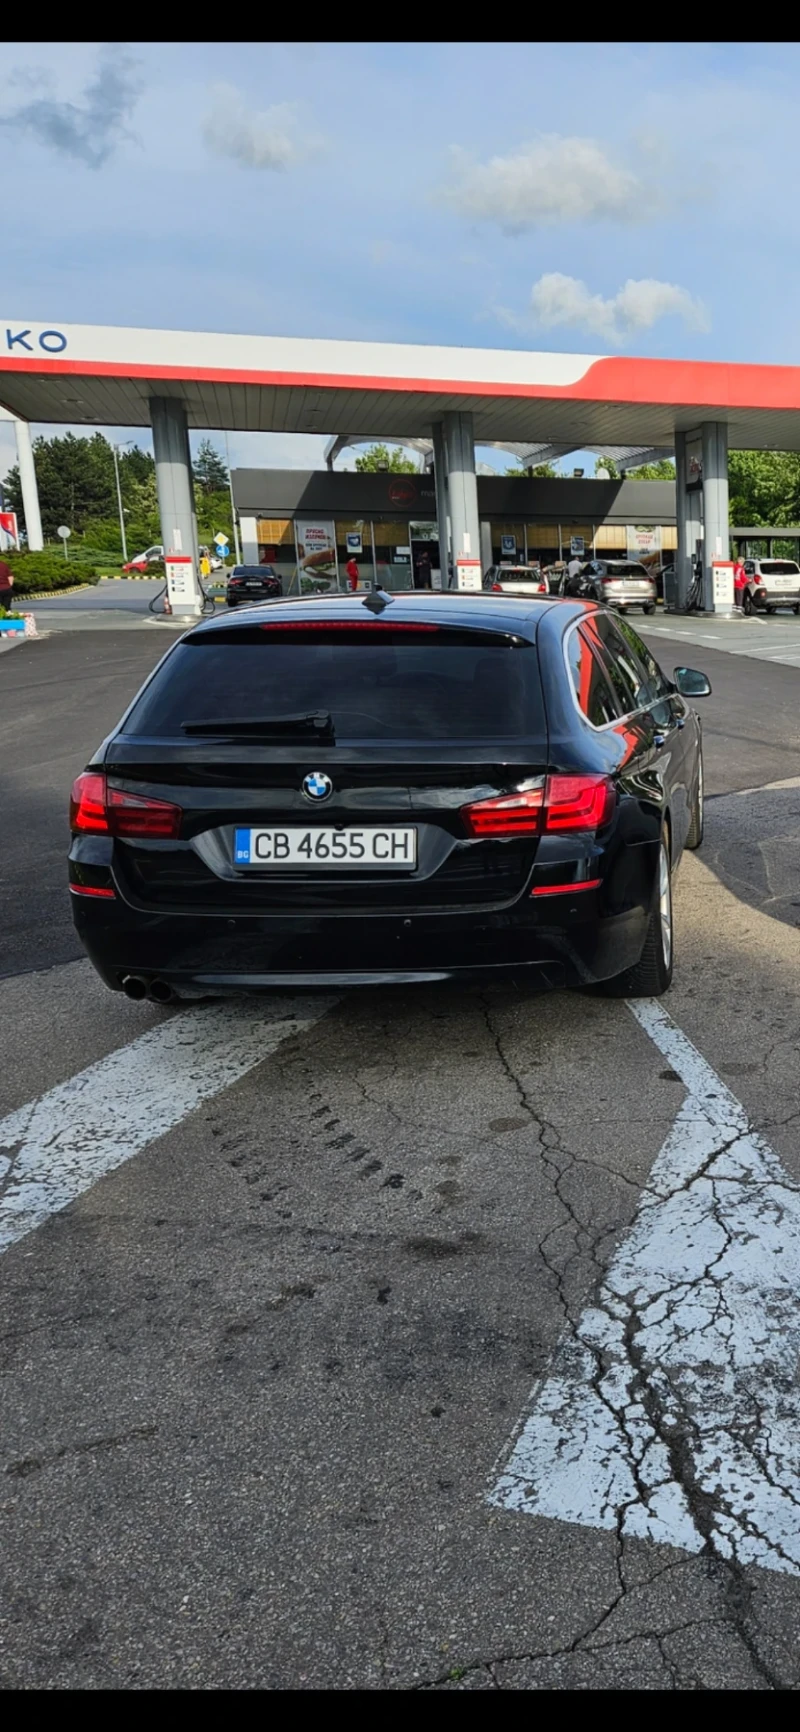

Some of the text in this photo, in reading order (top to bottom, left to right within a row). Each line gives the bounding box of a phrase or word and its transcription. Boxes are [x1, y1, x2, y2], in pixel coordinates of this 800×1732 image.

[6, 328, 67, 353] KO
[237, 832, 409, 859] BG CB 4655 CH
